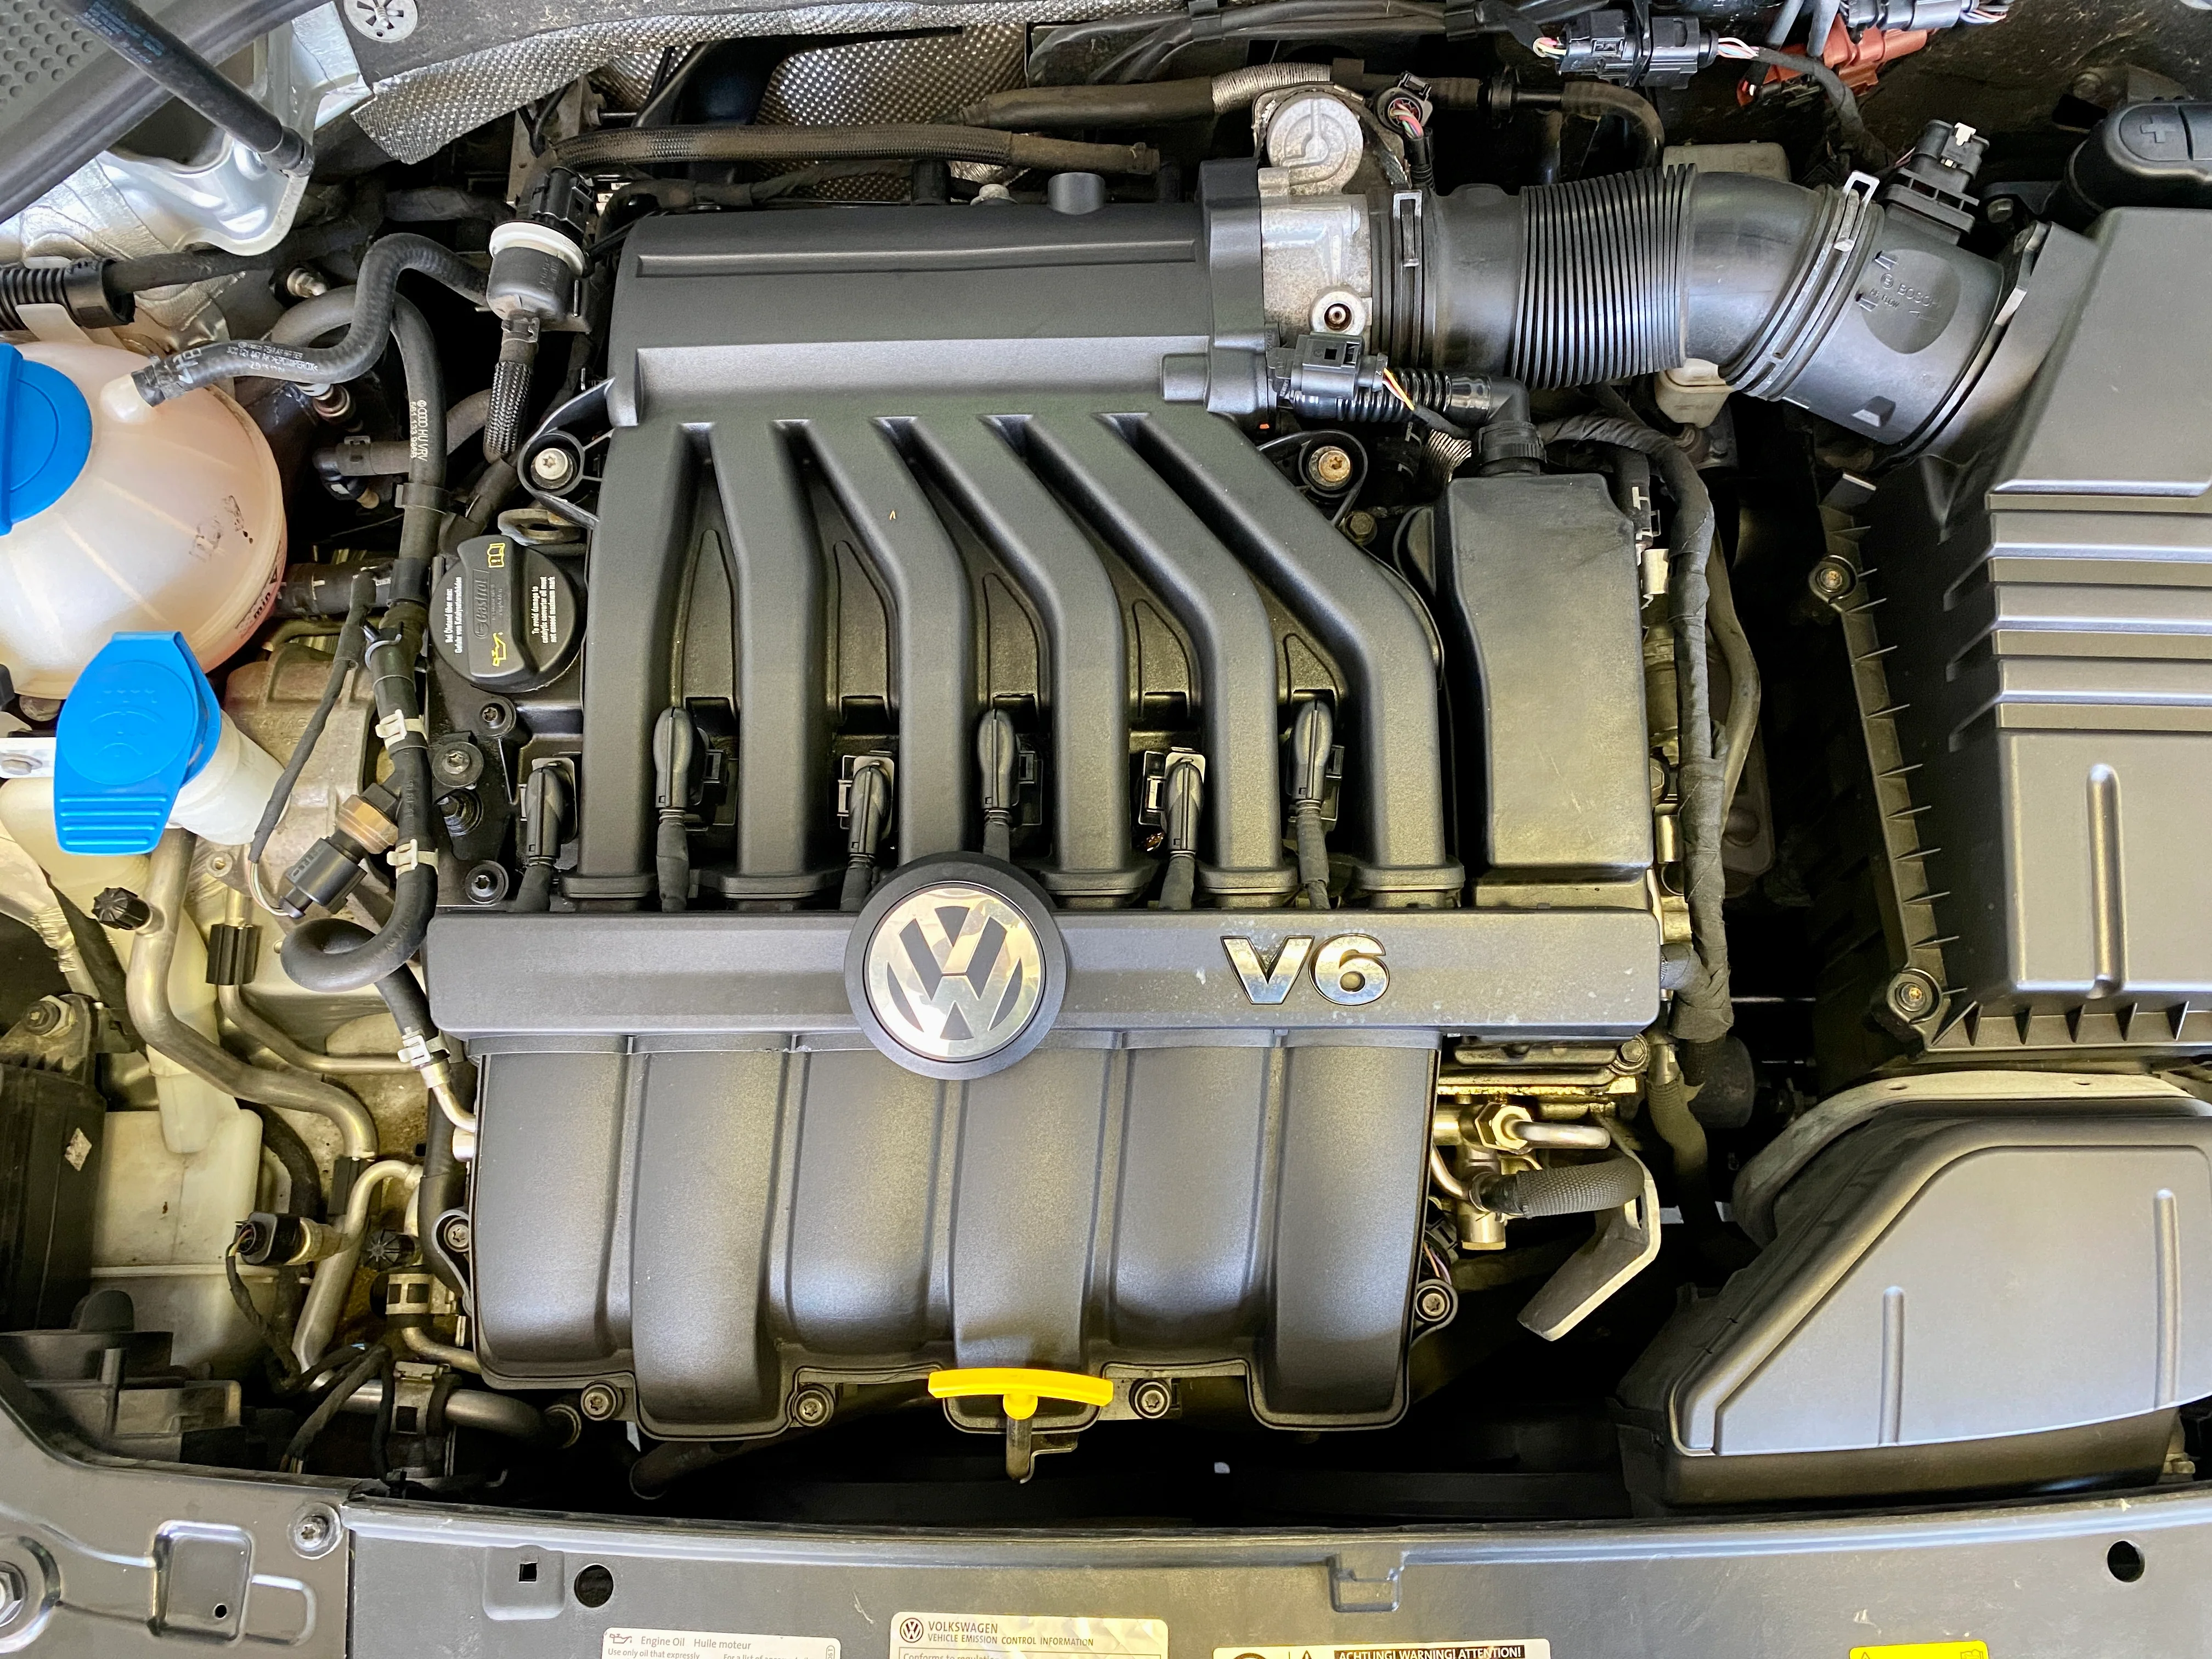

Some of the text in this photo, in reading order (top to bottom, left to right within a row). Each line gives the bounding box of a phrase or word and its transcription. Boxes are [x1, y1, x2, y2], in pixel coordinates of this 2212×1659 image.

[1898, 283, 1939, 308] BOSCH
[253, 592, 271, 619] min
[474, 580, 487, 622] Castrol
[531, 592, 540, 612] damage
[531, 613, 539, 627] avoid
[548, 616, 556, 633] exceed
[540, 622, 549, 644] catalytic
[866, 883, 1045, 1061] VW
[1220, 933, 1390, 1006] V6
[928, 1621, 998, 1634] VOLKSWAGEN
[641, 1636, 670, 1647] Engine
[673, 1638, 685, 1646] Oil
[719, 1641, 751, 1650] moteur
[928, 1633, 1093, 1646] VEHICLE EMISSION CONTROL INFORMATION
[623, 1649, 637, 1658] only
[1339, 1646, 1521, 1659] ACHTUNG! WARNING! ATTENTION!
